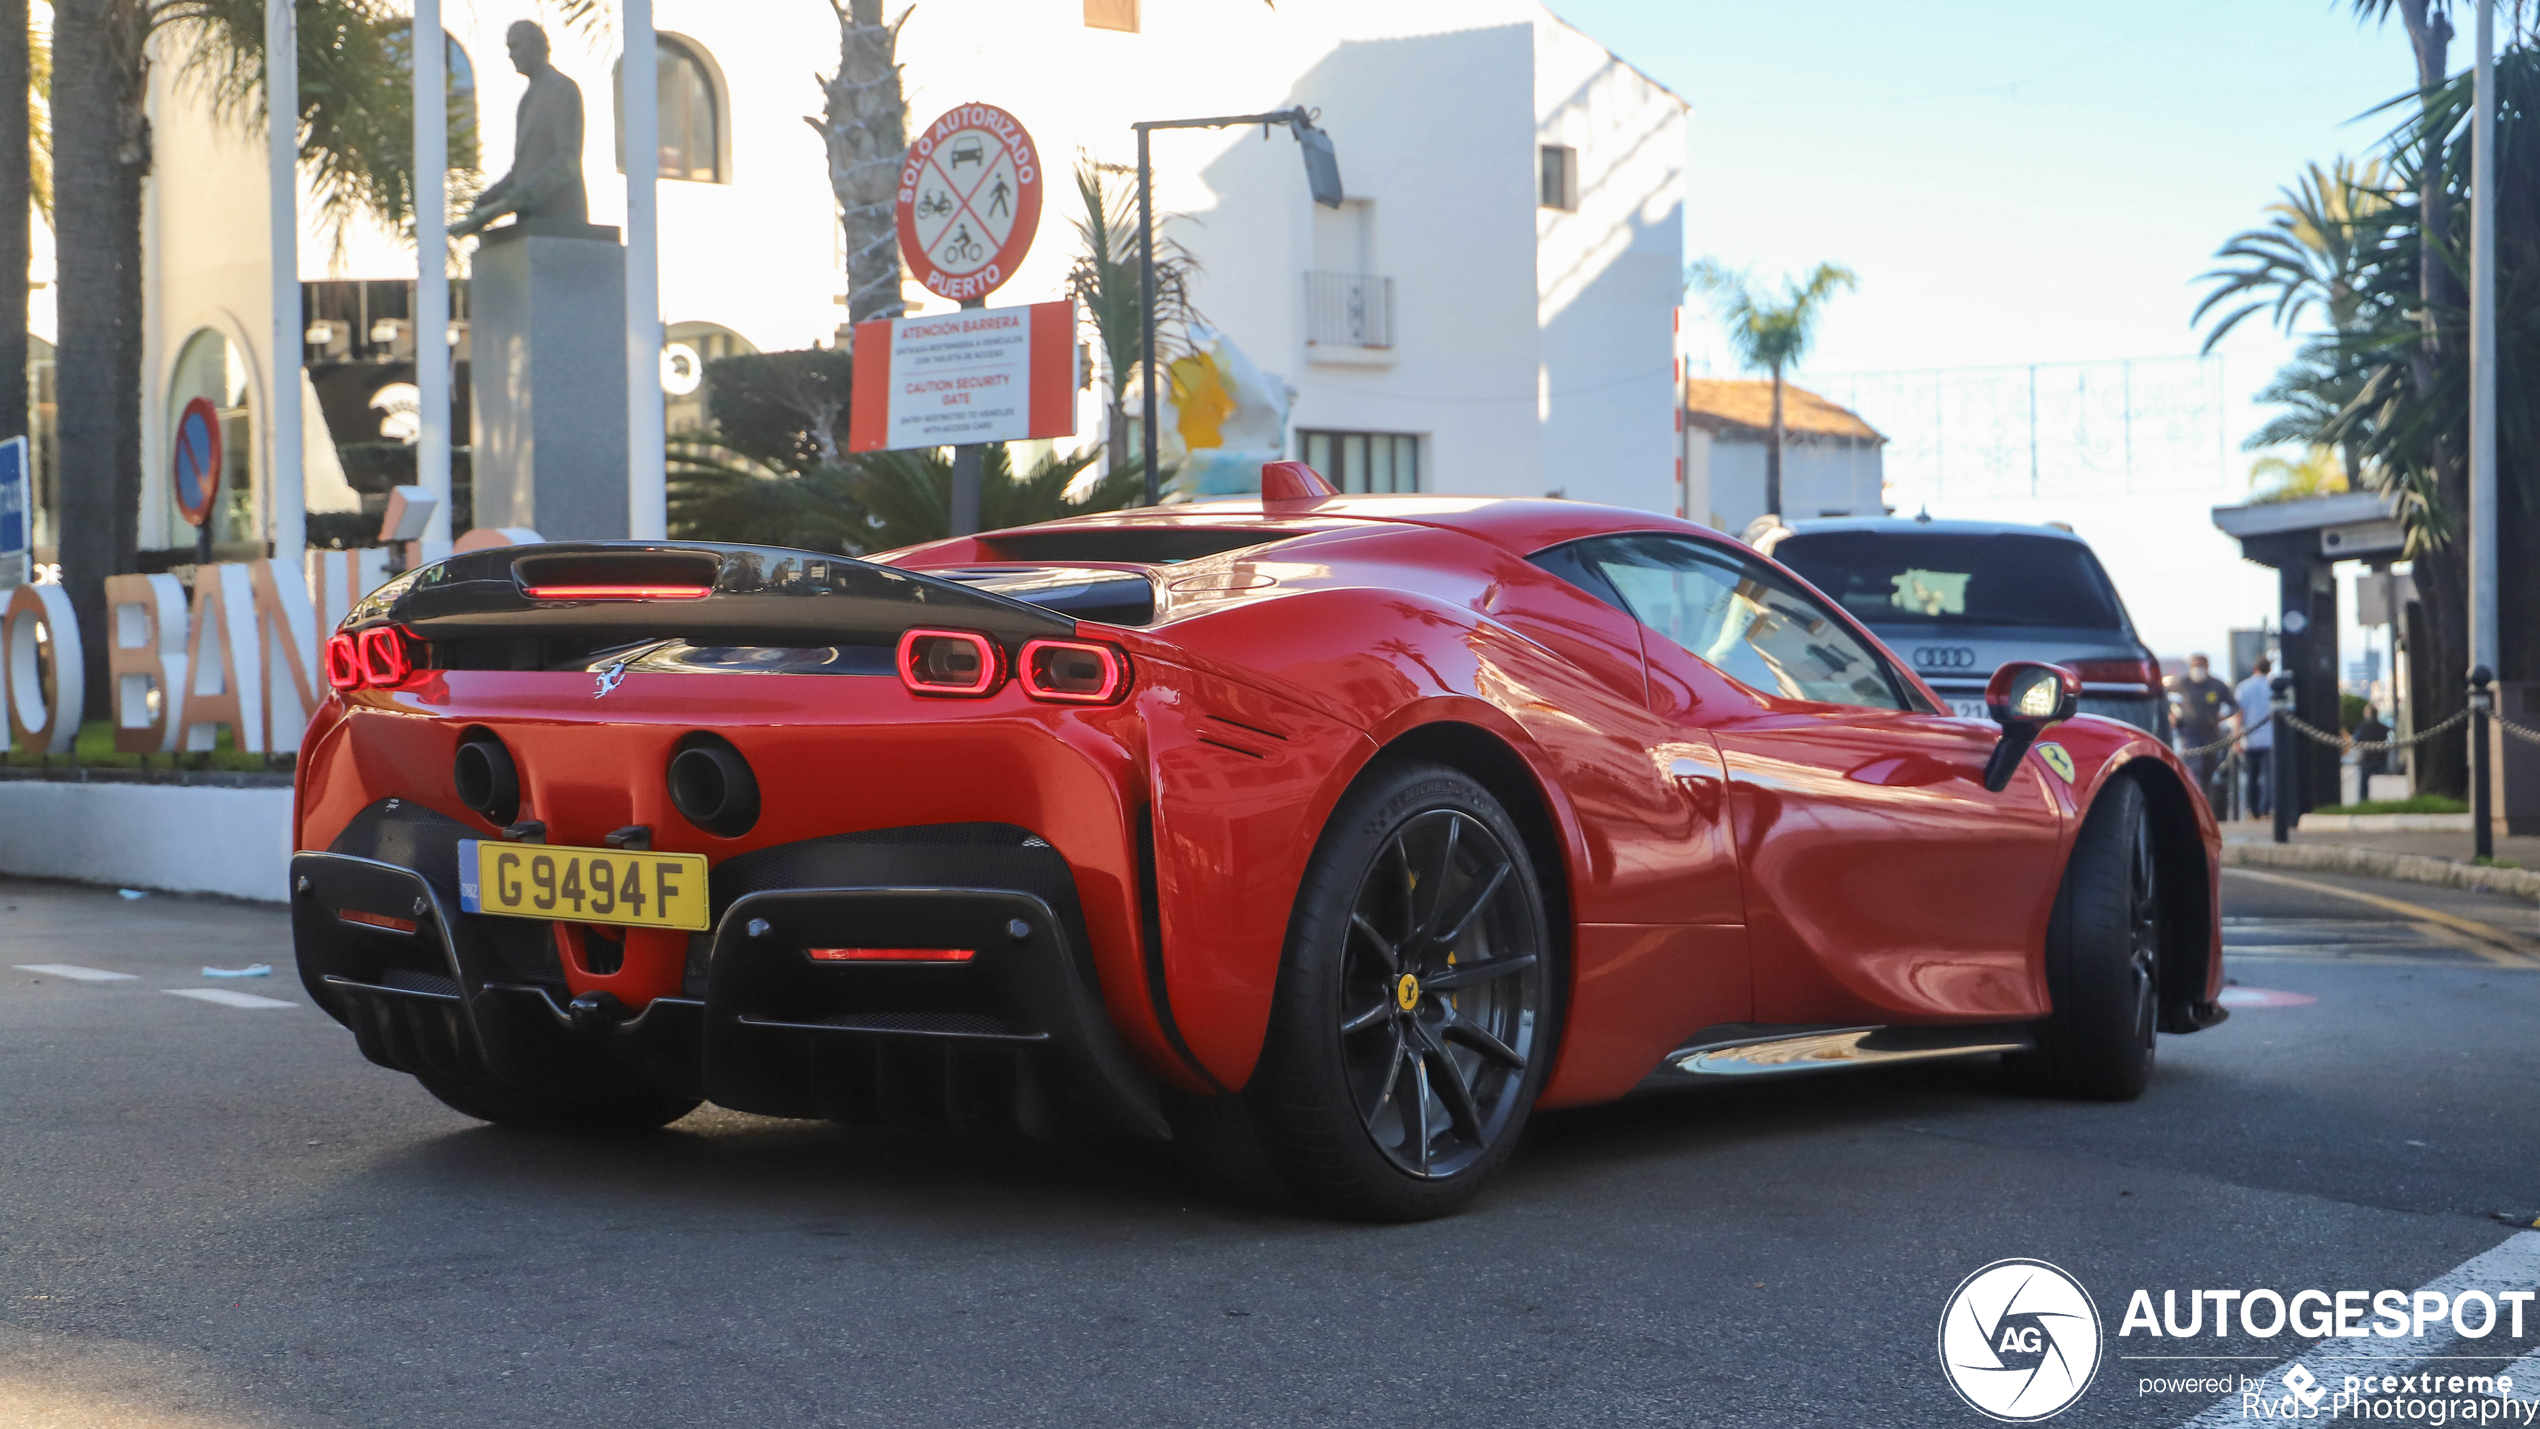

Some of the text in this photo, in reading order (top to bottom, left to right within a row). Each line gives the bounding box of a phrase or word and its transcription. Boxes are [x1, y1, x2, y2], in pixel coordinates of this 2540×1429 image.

[898, 106, 1035, 204] SOLO AUTORIZADO
[926, 265, 1000, 298] PUERTO
[902, 316, 1019, 339] ATENCIÓN BARRERA
[906, 373, 1010, 394] CAUTION SECURITY
[942, 392, 970, 406] GATE
[497, 852, 683, 918] G9494F
